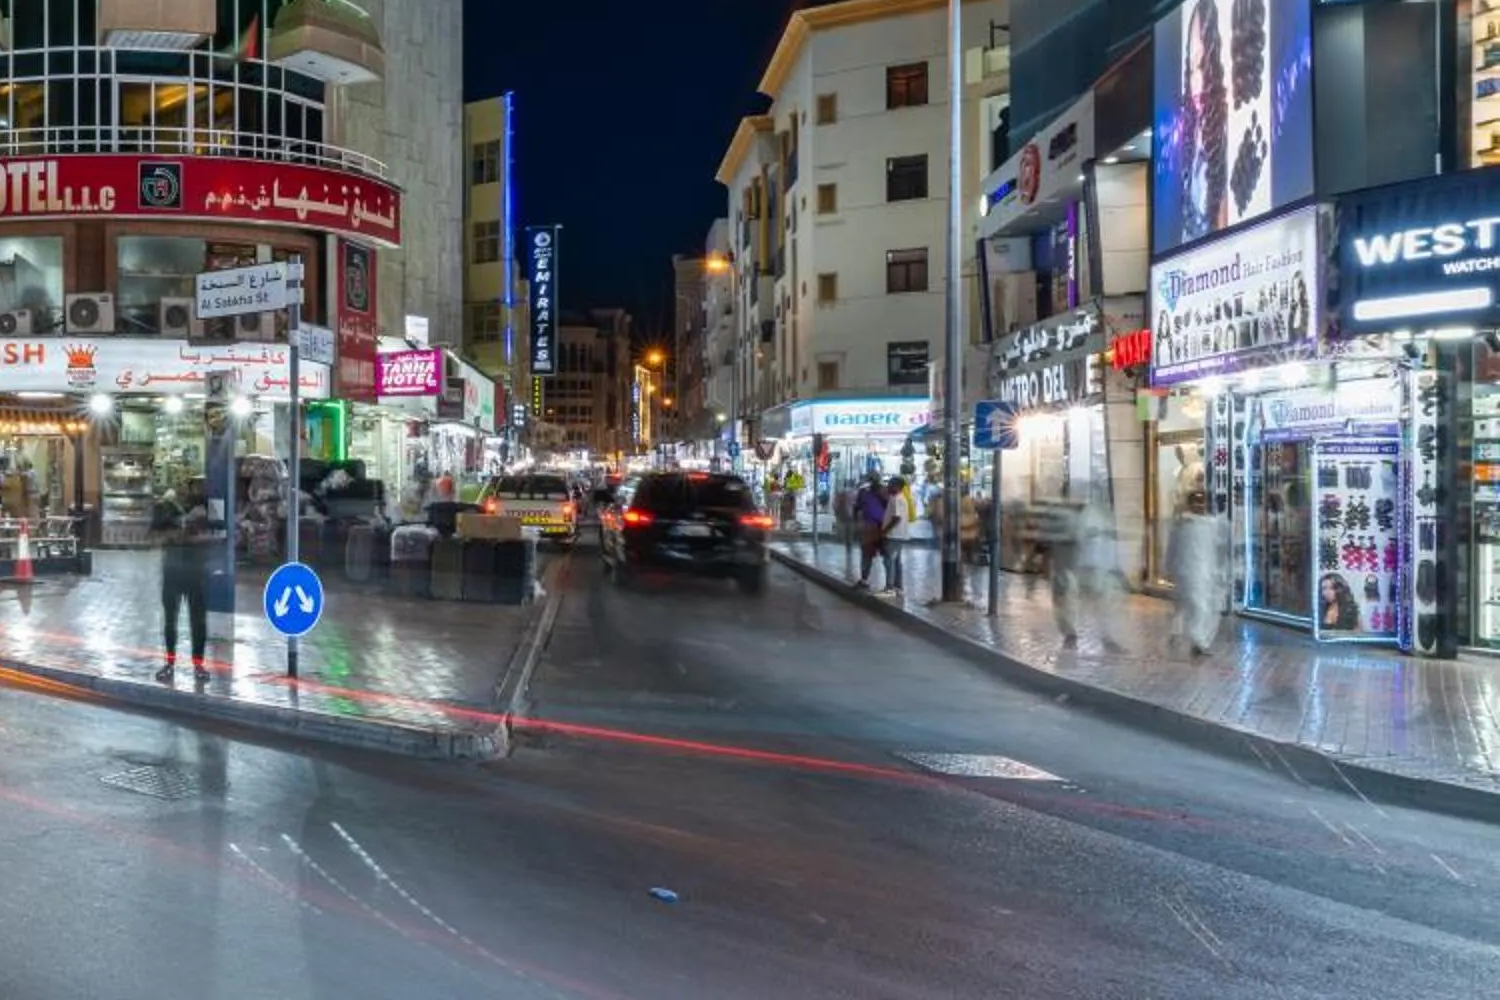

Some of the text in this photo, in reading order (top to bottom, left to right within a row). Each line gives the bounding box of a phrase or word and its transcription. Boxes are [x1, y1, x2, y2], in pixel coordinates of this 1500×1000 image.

[64, 185, 117, 212] L.L.C
[272, 177, 349, 221] تنها
[351, 185, 395, 230] فندق
[1353, 216, 1500, 267] WEST
[1170, 251, 1242, 301] Diamond
[1442, 256, 1500, 275] WATCH
[534, 257, 551, 361] EMIRATES
[381, 361, 436, 376] TANHA
[381, 373, 433, 386] HOTEL
[1001, 371, 1040, 408] METRO
[1043, 353, 1103, 404] DELE
